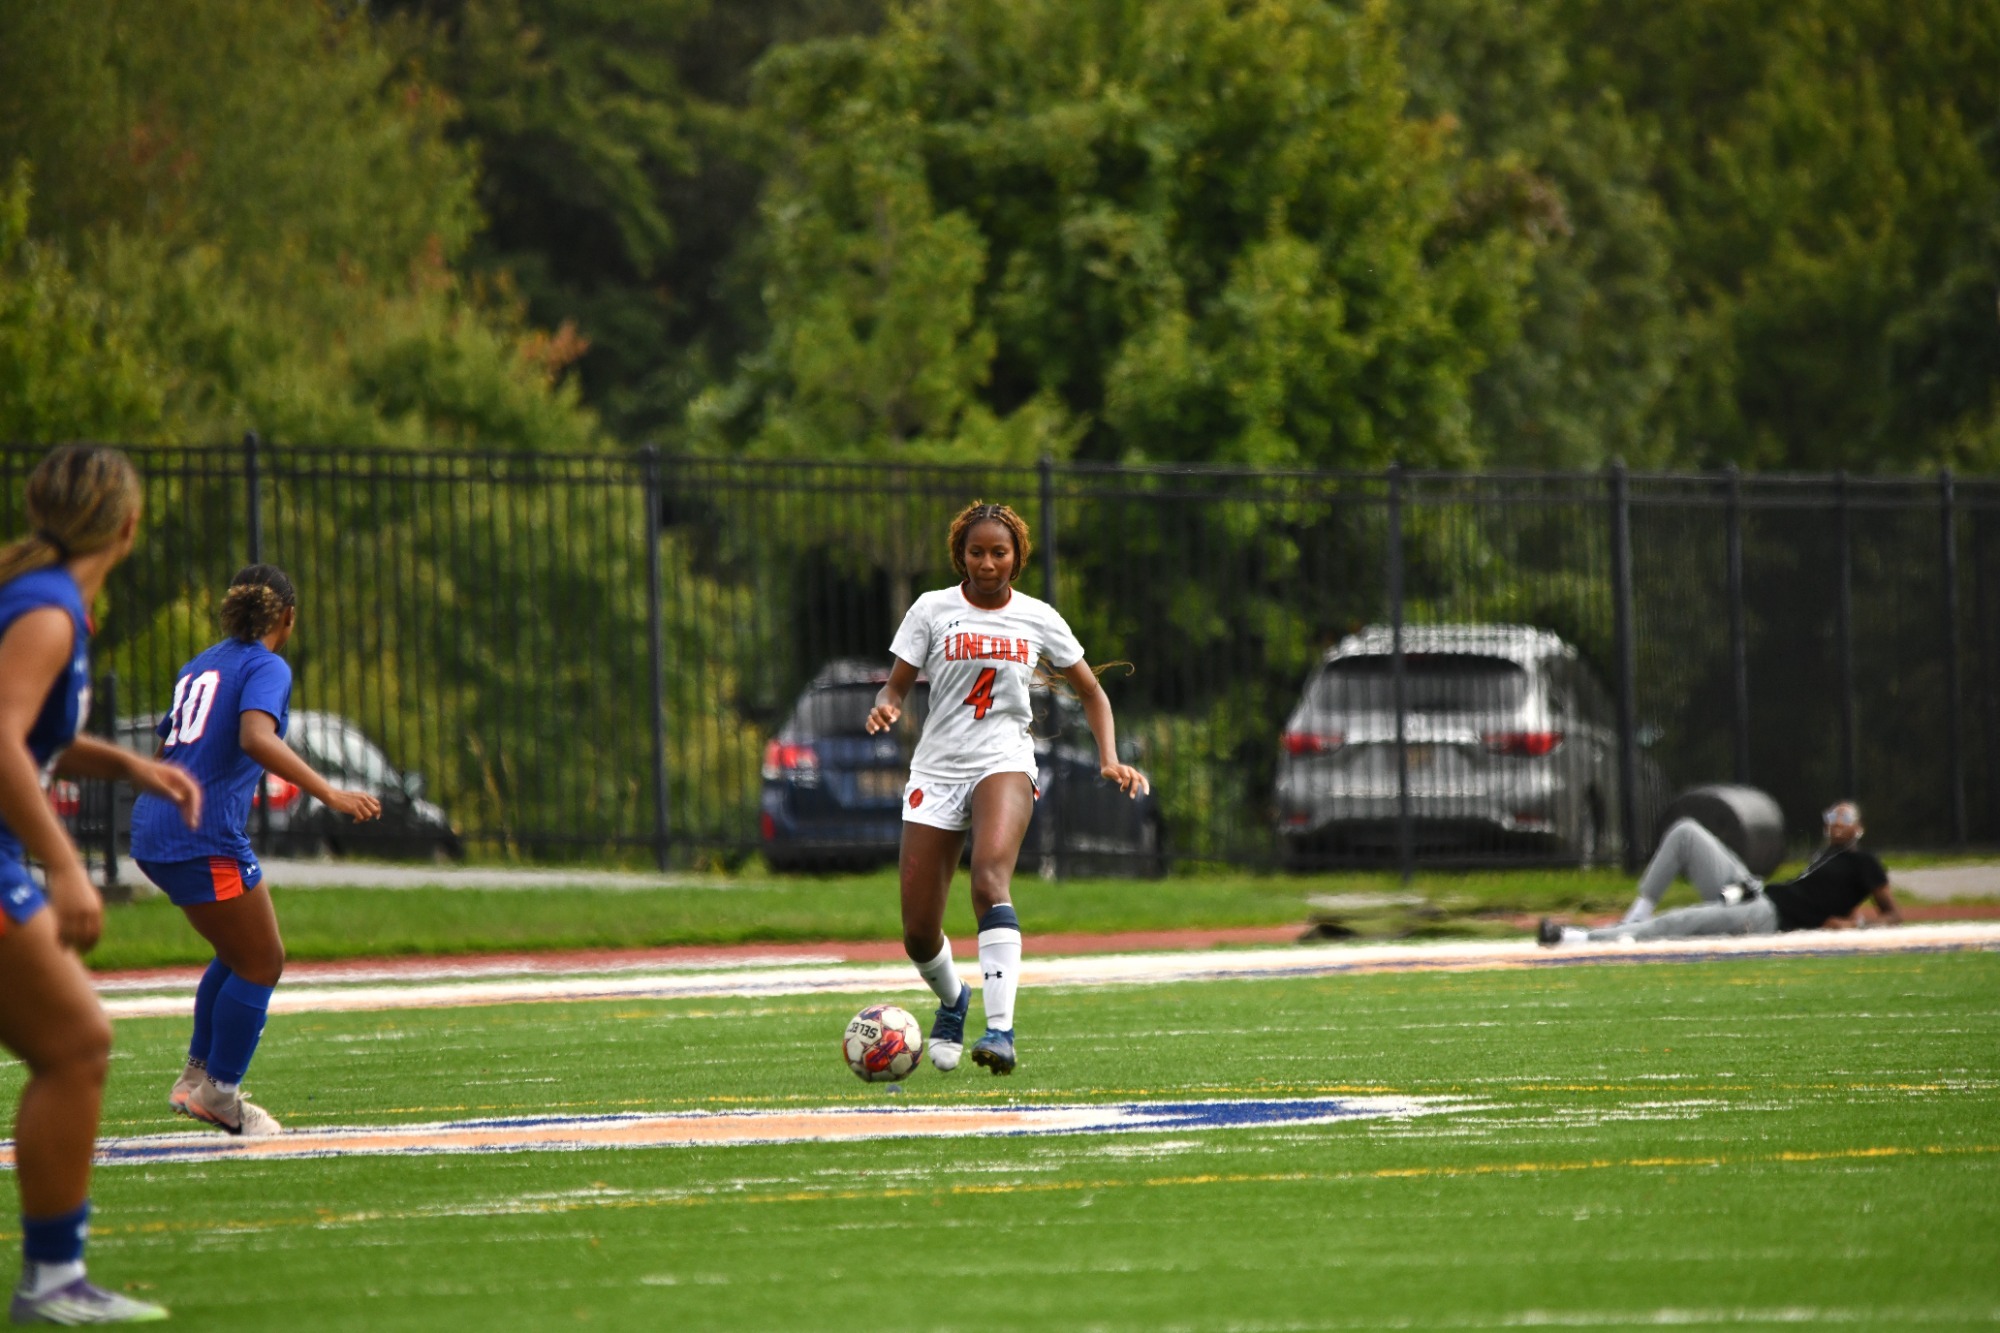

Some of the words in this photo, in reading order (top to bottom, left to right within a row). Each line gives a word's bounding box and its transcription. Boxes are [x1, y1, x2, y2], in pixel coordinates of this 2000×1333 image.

[944, 632, 1029, 665] LINCOLN
[164, 669, 221, 746] 10
[962, 667, 997, 720] 4
[847, 1022, 878, 1039] SELEC
